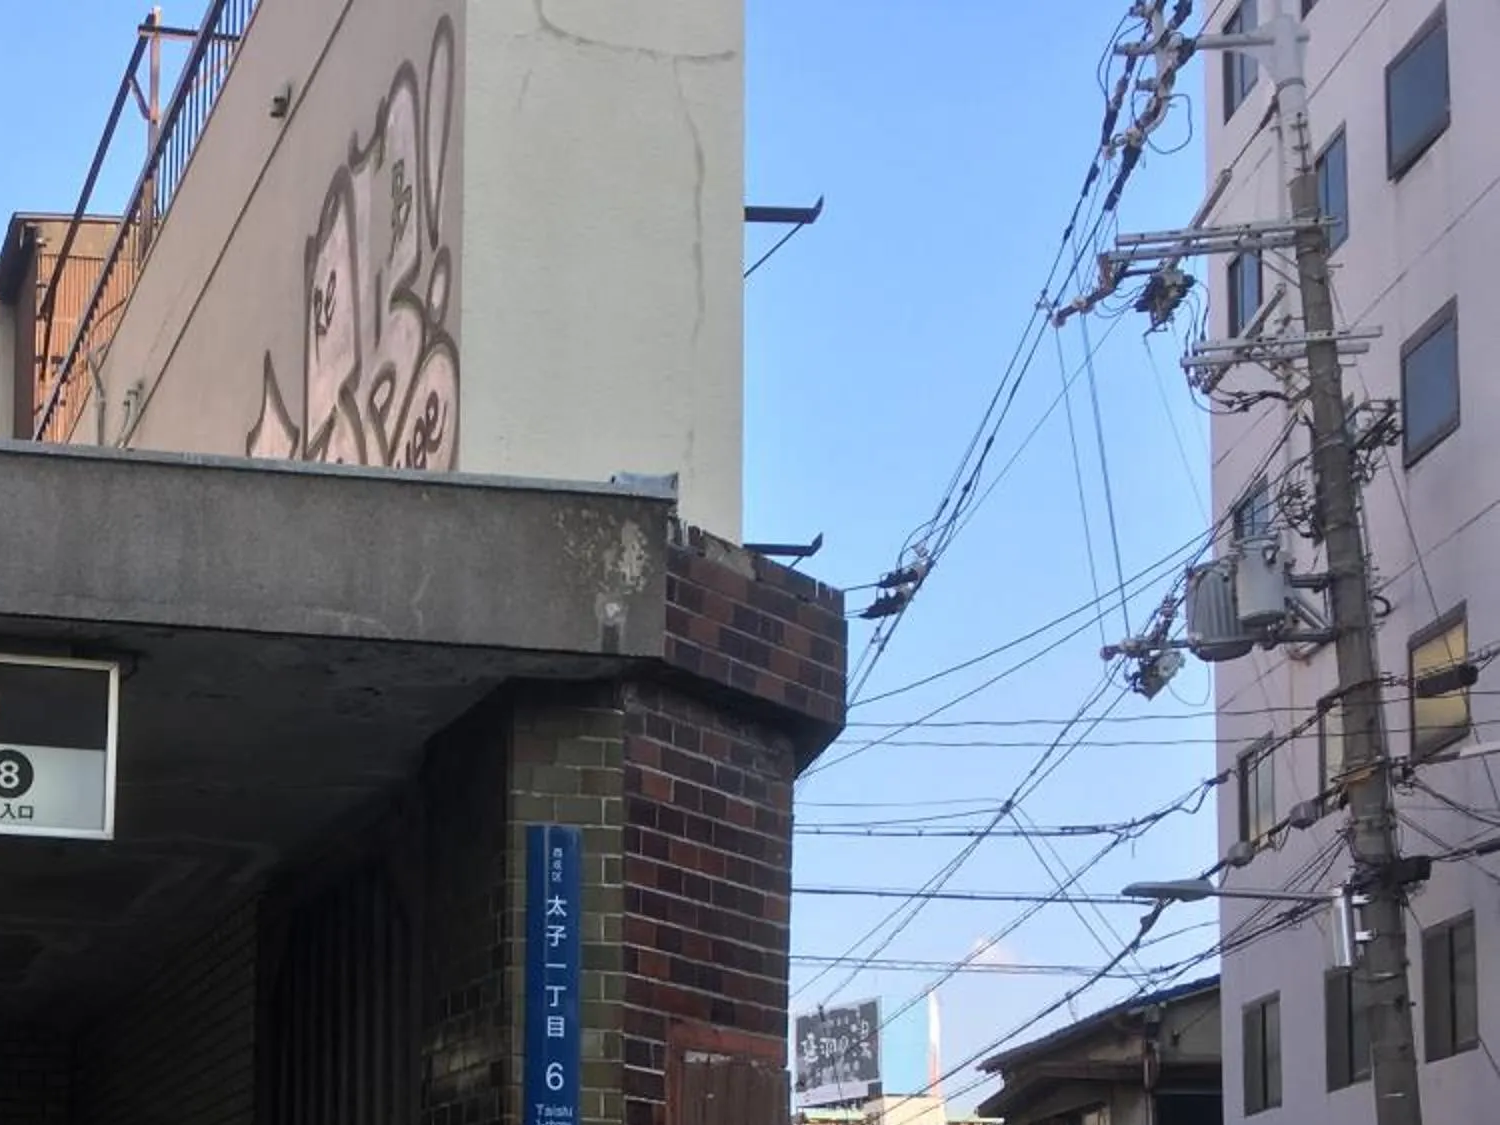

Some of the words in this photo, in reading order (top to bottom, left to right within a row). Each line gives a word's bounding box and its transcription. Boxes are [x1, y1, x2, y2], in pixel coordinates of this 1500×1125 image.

[544, 895, 568, 1039] 太子一丁目
[545, 1062, 566, 1092] 6
